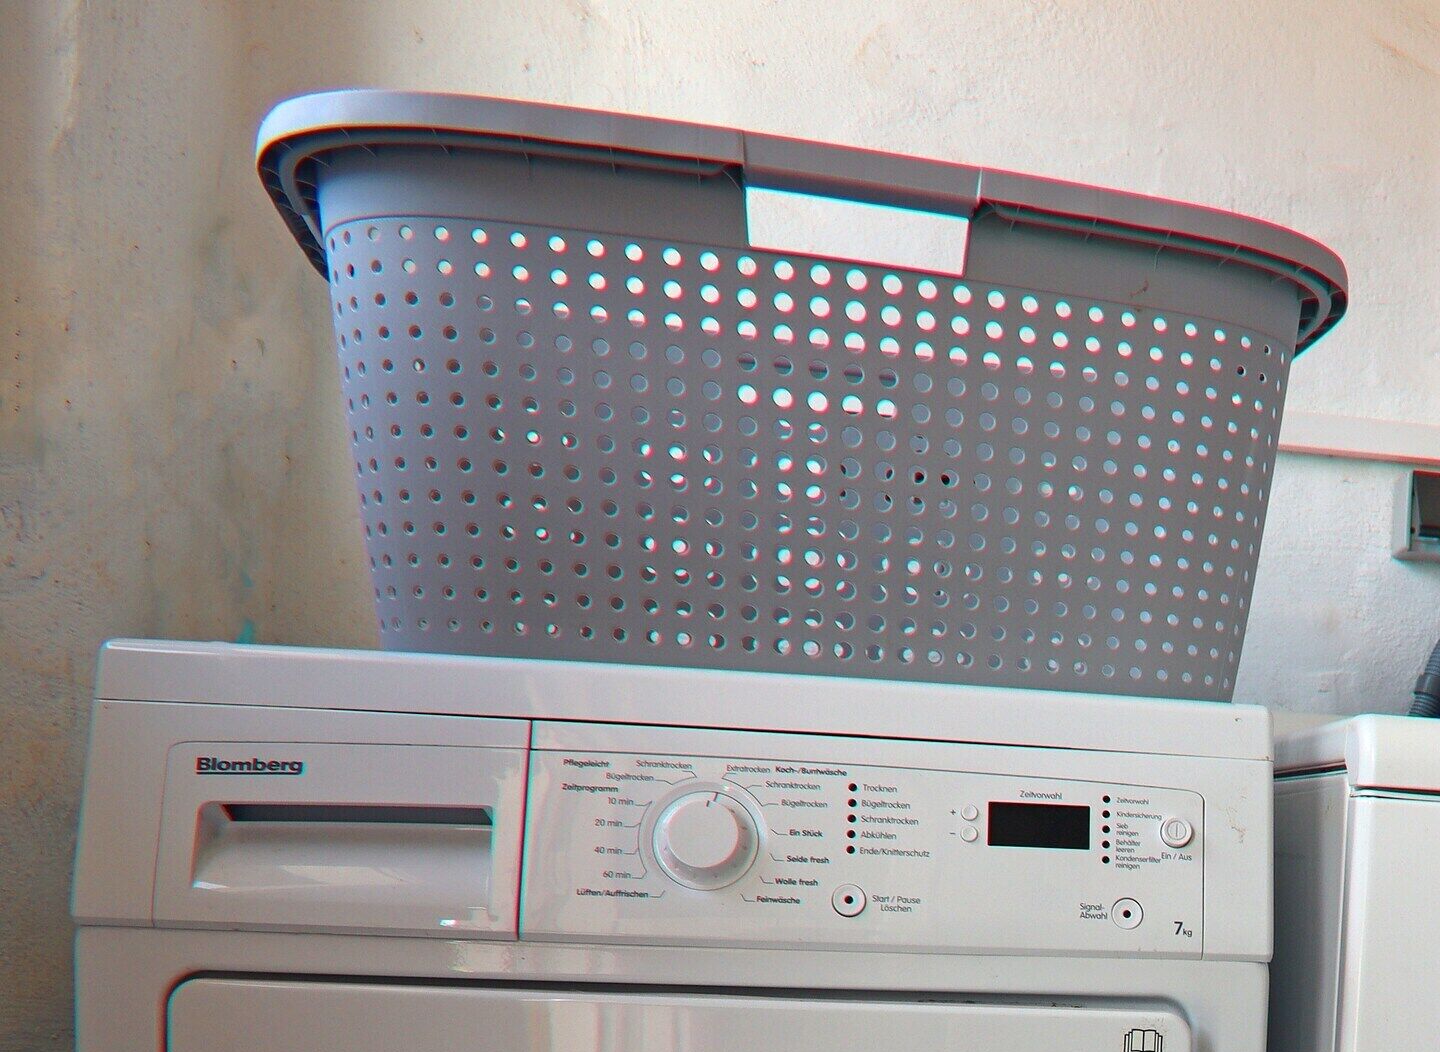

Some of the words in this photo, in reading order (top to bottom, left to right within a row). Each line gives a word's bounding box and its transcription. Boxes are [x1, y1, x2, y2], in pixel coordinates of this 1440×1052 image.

[196, 757, 304, 775] Blomberg
[563, 759, 609, 768] Pflegeleicht
[636, 760, 693, 769] Schranktrocken
[726, 765, 771, 774] Extratrocken
[605, 772, 655, 781] Bügeltrocken
[562, 783, 619, 793] Zeitprogramm
[765, 781, 821, 790] Schranktrocken
[863, 784, 898, 793] Trocknen
[1020, 790, 1062, 800] Zeitvorwahl
[608, 797, 616, 805] 10
[781, 799, 828, 808] Bügeltrocken
[861, 800, 911, 810] Bügeltrocken
[861, 815, 919, 825] Schranktrocken
[1116, 812, 1162, 820] Kindersicherung
[595, 819, 605, 827] 20
[606, 819, 623, 827] min
[801, 830, 823, 838] Stück
[861, 831, 897, 840] Abkühlen
[787, 855, 808, 863] Seide
[810, 856, 830, 864] fresh
[1161, 852, 1172, 860] Ein
[1178, 853, 1192, 861] Aus
[603, 870, 613, 878] 60
[775, 878, 797, 886] Wolle
[757, 895, 800, 904] Feinwäsche
[872, 895, 890, 903] Start
[897, 896, 921, 904] Pause
[880, 904, 912, 912] Löschen
[1080, 903, 1105, 912] Signal-
